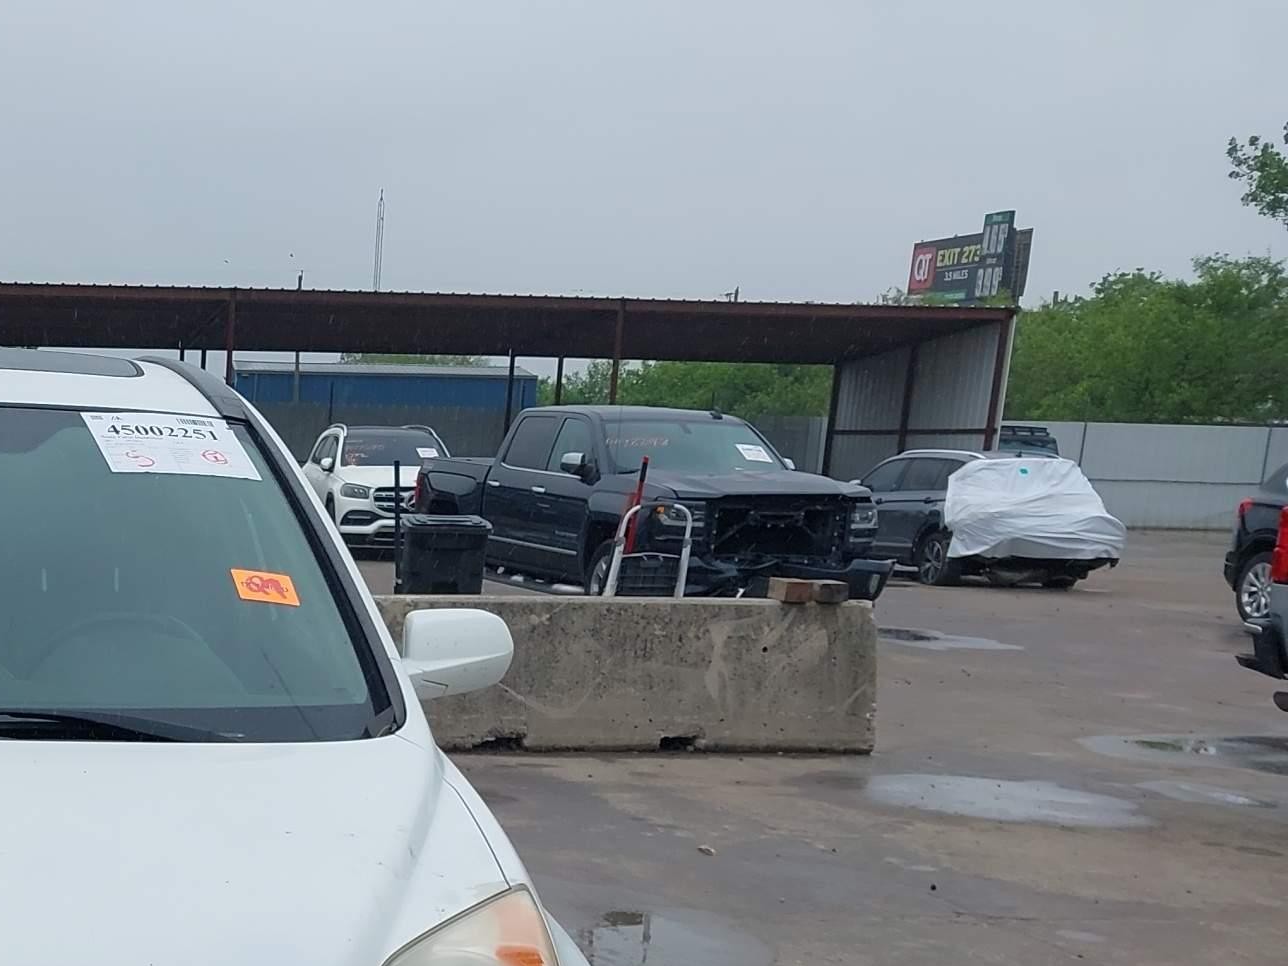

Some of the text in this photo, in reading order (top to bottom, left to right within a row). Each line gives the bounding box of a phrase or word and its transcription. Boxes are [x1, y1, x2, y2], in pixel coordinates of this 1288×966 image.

[914, 253, 933, 281] QT
[937, 247, 960, 268] EXIT
[107, 424, 219, 441] 45002251
